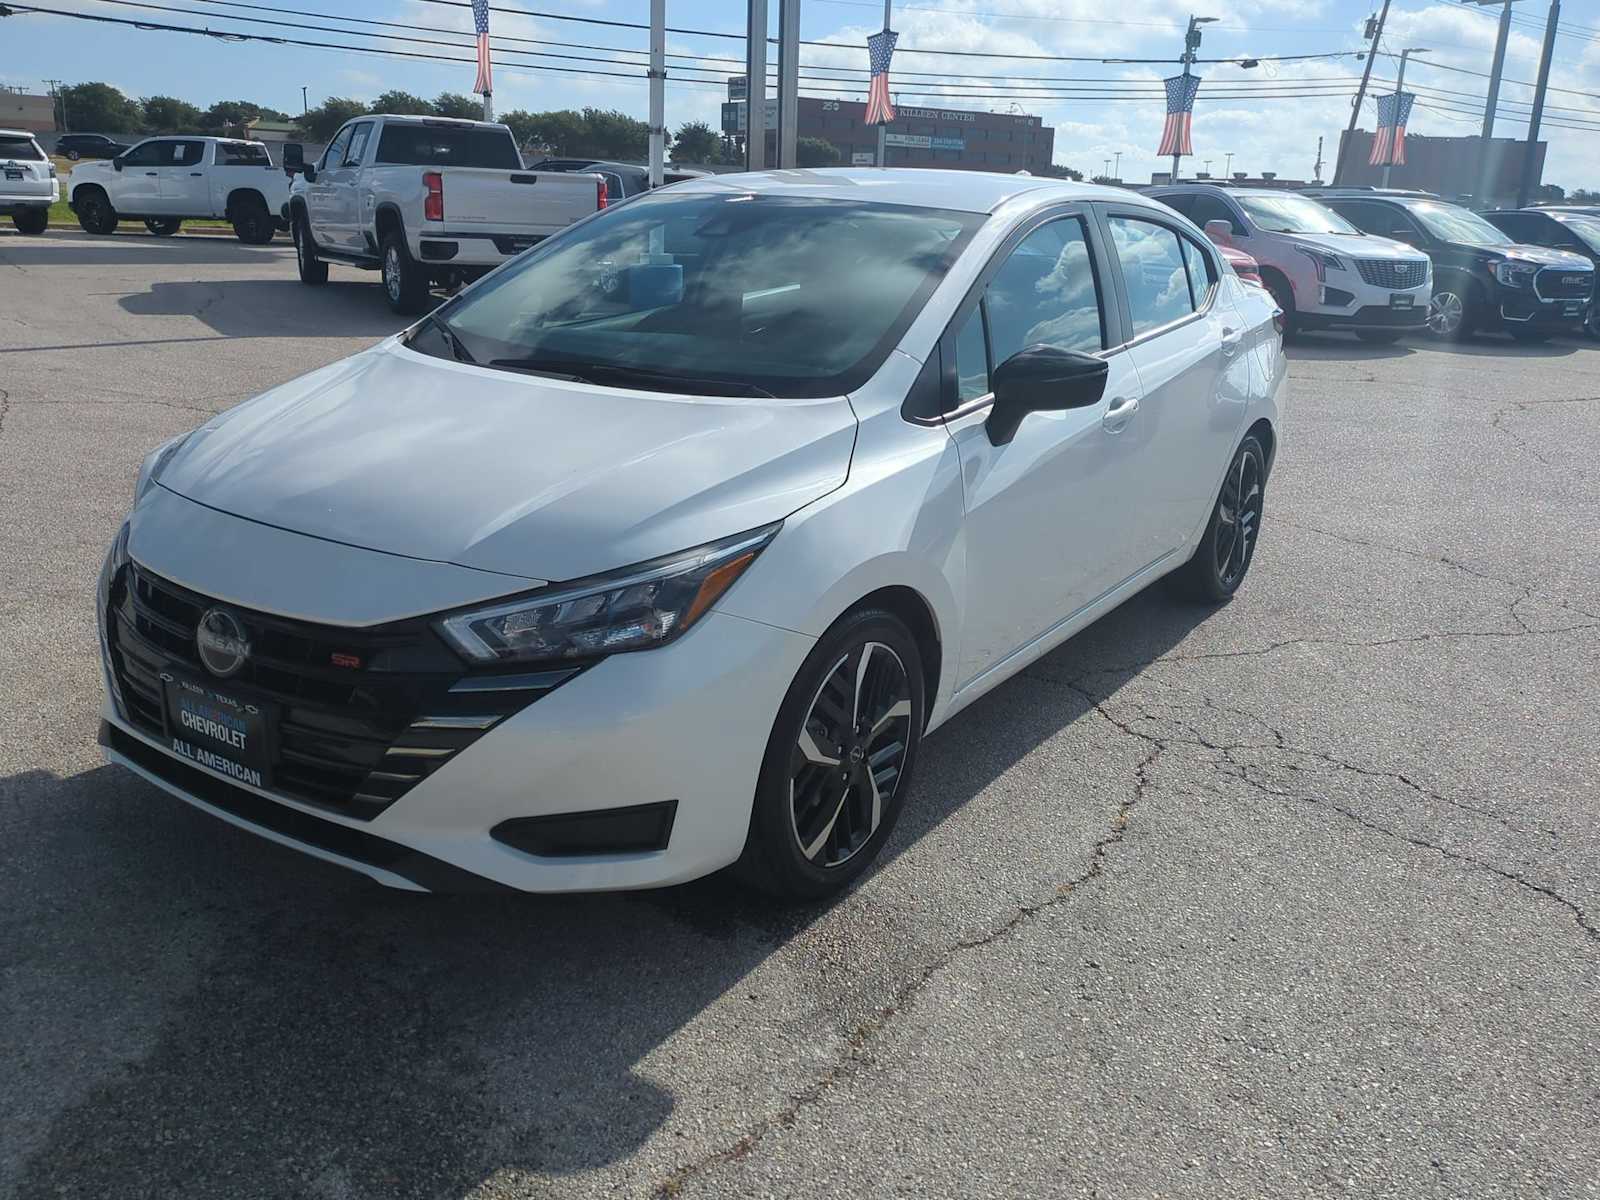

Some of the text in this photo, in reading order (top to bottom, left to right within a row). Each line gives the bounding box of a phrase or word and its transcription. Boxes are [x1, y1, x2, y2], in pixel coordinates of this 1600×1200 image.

[899, 108, 976, 122] KILLEEN CENTER
[201, 633, 249, 656] SSAN
[331, 652, 360, 669] SR
[181, 709, 247, 750] CHEVROLET
[172, 738, 262, 787] ALL AMERICAN
